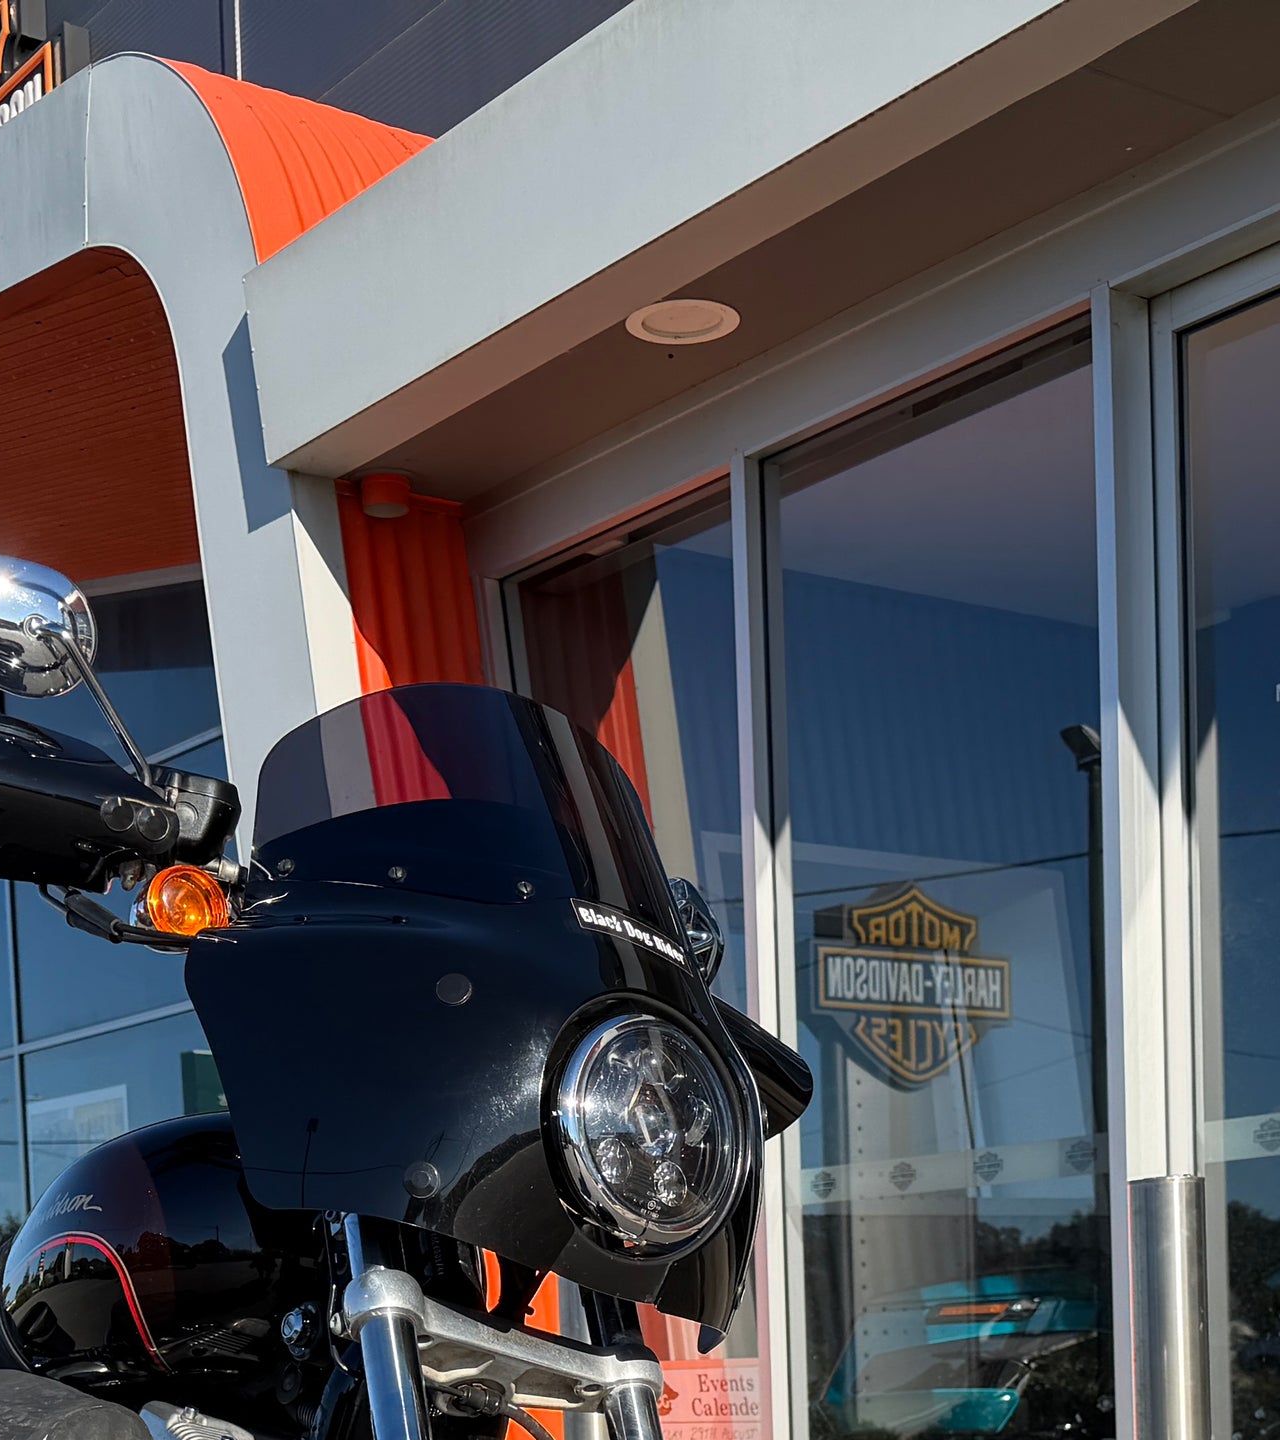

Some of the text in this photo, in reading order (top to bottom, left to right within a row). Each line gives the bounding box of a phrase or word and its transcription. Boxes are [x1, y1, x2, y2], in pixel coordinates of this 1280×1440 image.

[578, 906, 685, 966] Black Dog Rider
[697, 1374, 754, 1393] Events
